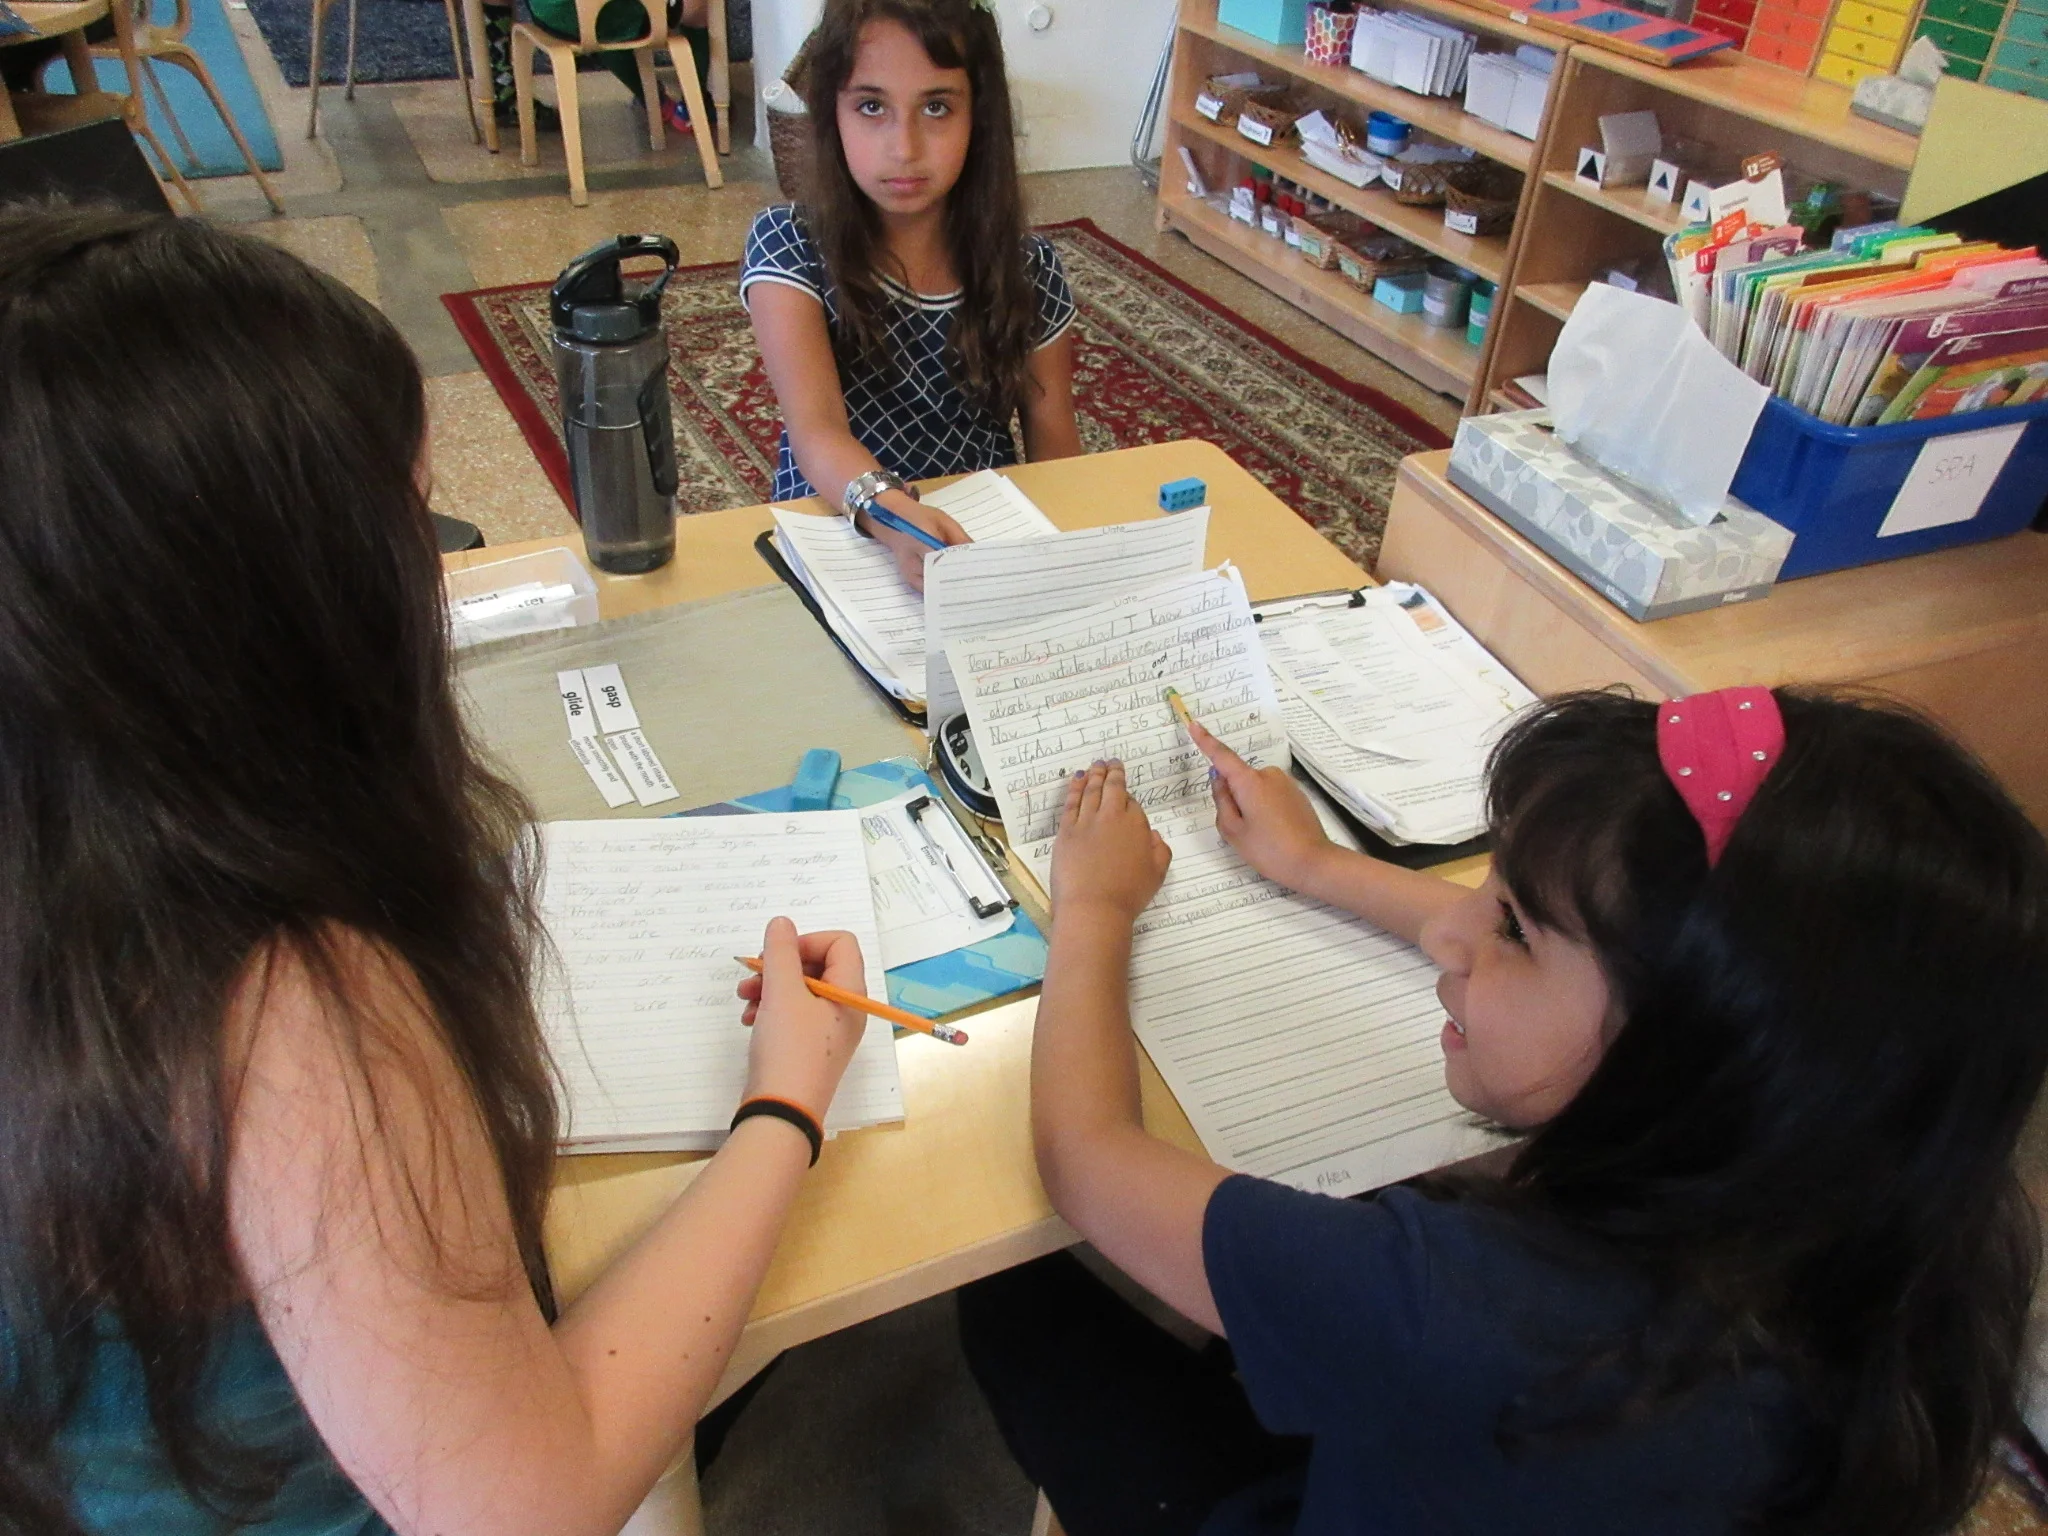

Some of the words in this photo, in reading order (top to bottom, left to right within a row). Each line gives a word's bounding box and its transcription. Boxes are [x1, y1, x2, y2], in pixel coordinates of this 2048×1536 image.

[1102, 525, 1125, 535] Date
[1113, 595, 1138, 608] Date
[968, 654, 992, 673] Dear
[1076, 621, 1115, 650] school
[1124, 613, 1138, 634] I
[1190, 587, 1232, 615] what
[1152, 652, 1169, 669] and
[601, 685, 622, 709] gasp
[975, 681, 1000, 697] are
[562, 691, 585, 717] glide
[989, 725, 1018, 746] Now
[1032, 714, 1048, 733] I
[1064, 708, 1080, 725] do
[1192, 672, 1211, 692] by
[1035, 736, 1063, 758] And
[1076, 728, 1092, 744] I
[1099, 720, 1124, 749] get
[1221, 685, 1255, 707] math
[582, 735, 595, 751] move
[606, 768, 619, 784] and
[628, 750, 640, 764] with
[1120, 740, 1148, 762] Now
[1169, 751, 1200, 764] becaus
[635, 761, 645, 771] the
[639, 769, 656, 788] mouth
[920, 845, 938, 867] Emma
